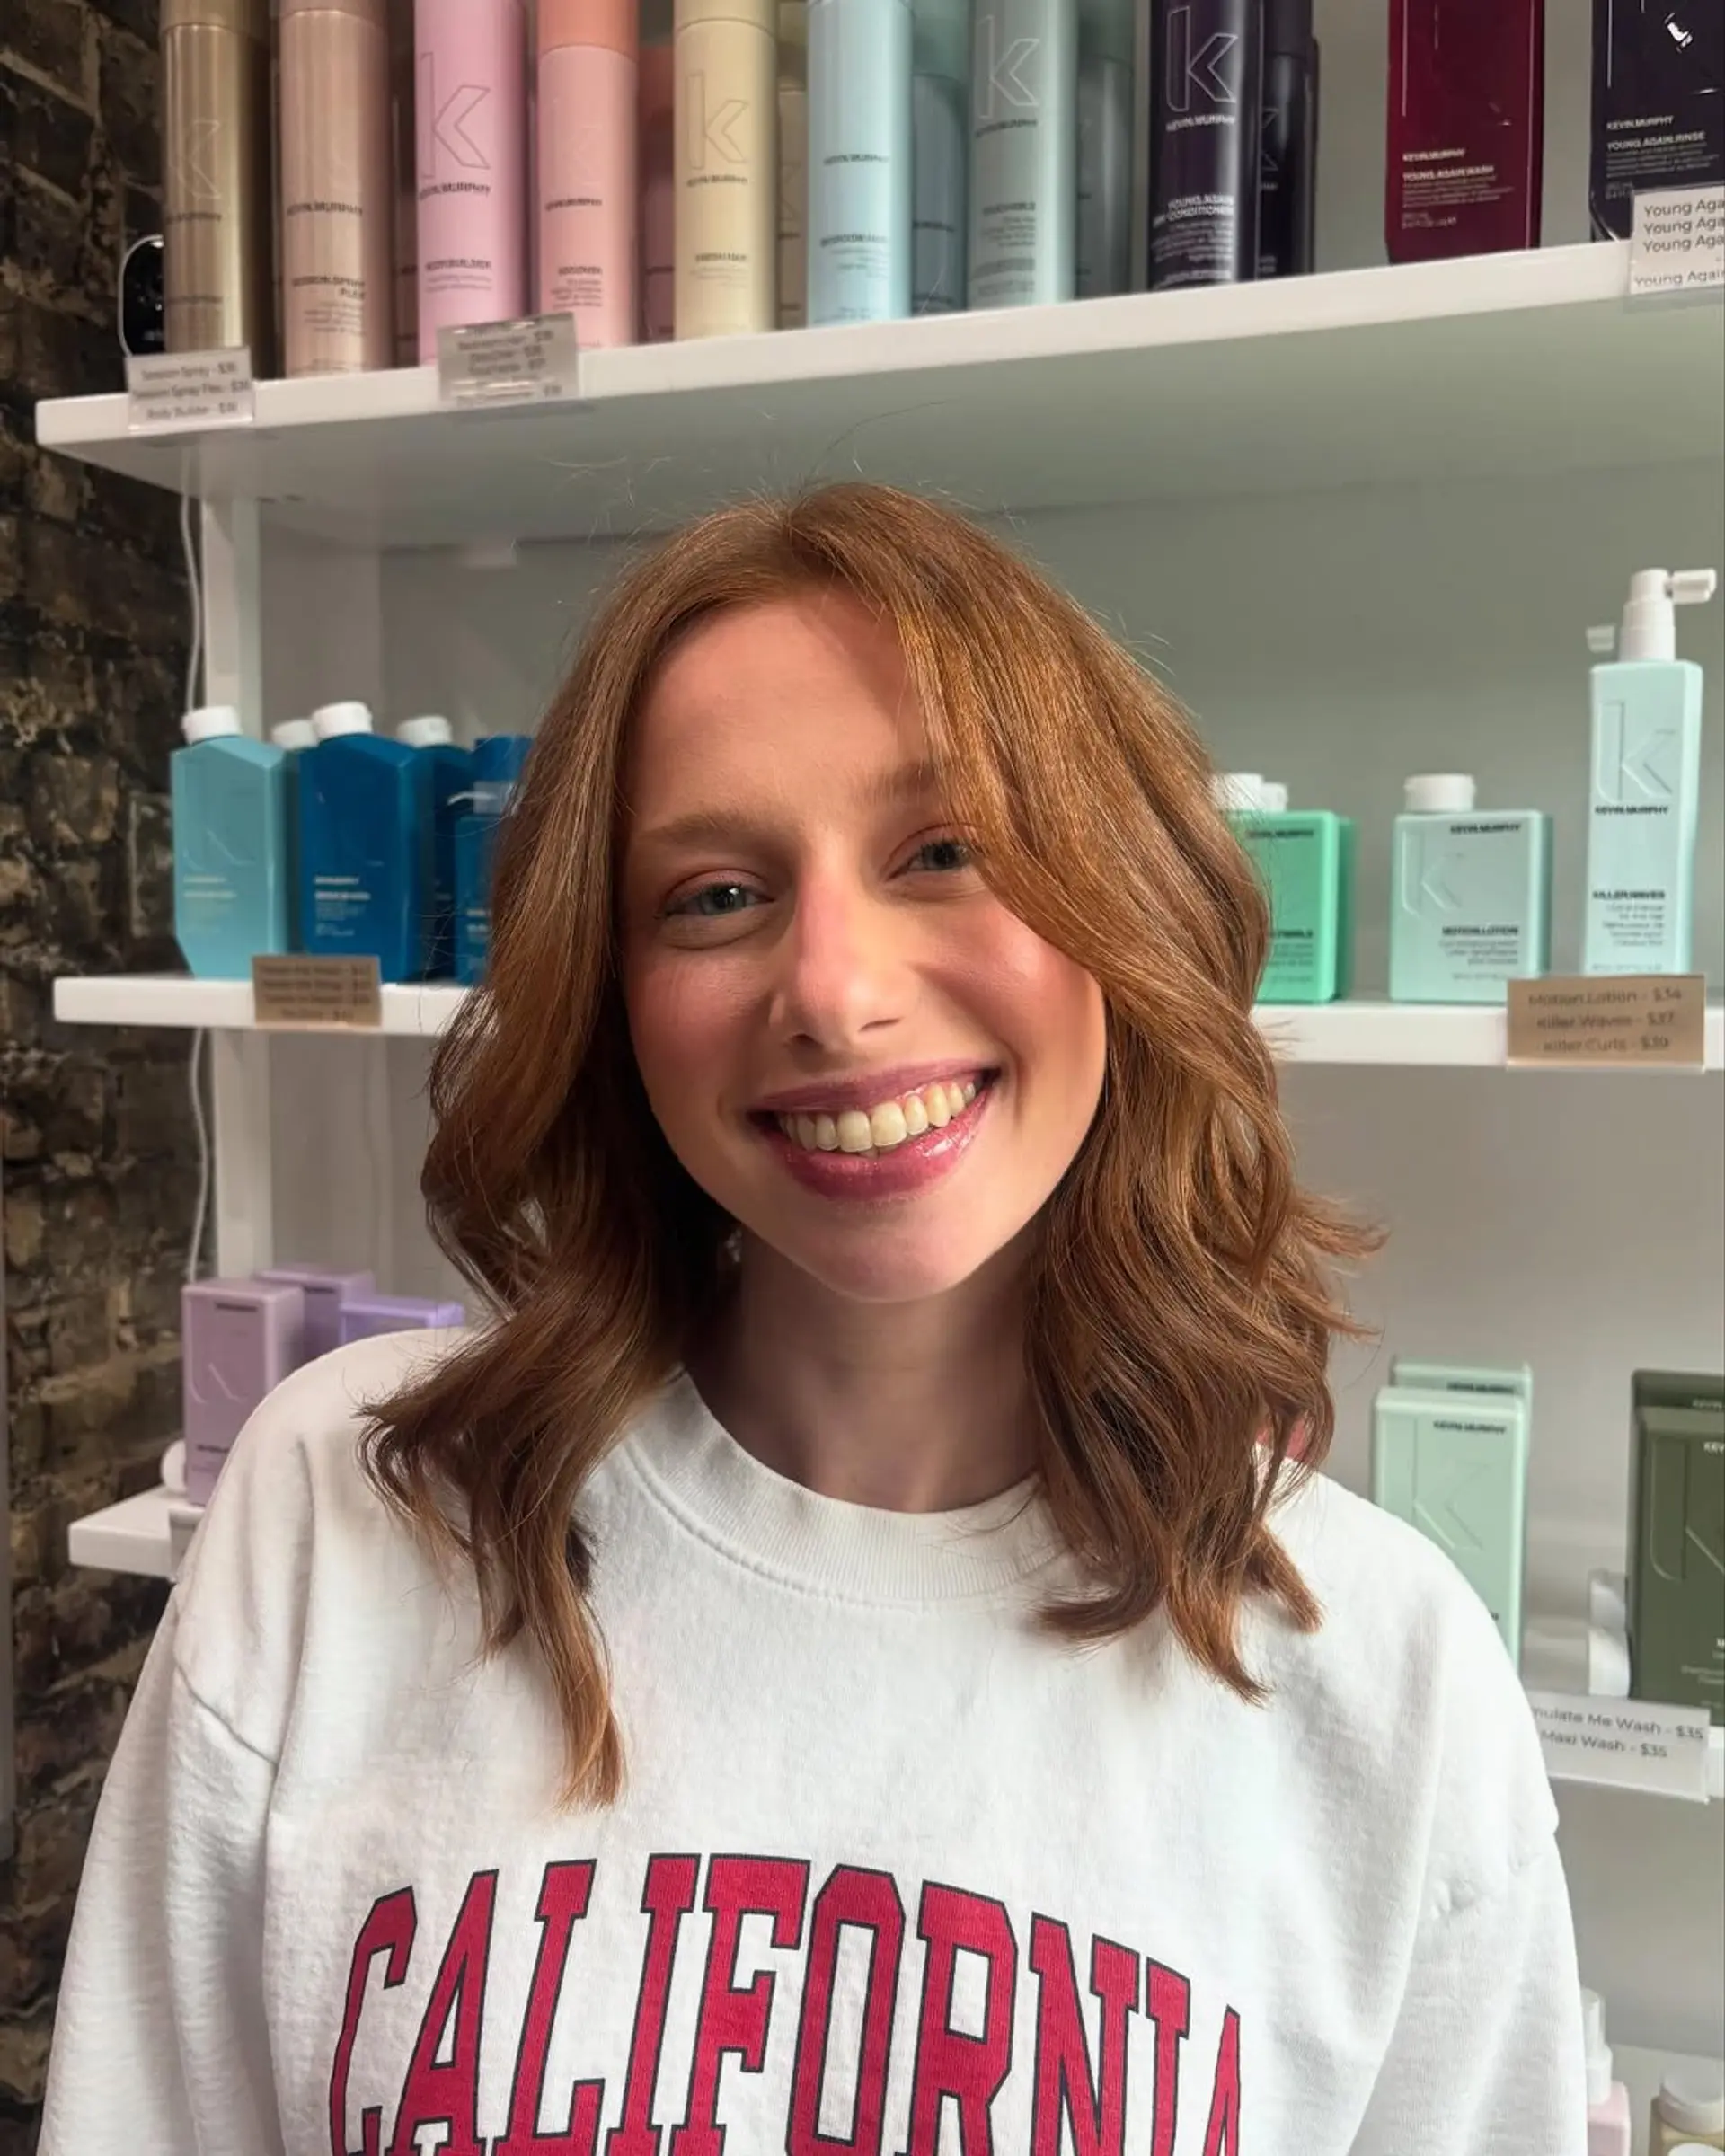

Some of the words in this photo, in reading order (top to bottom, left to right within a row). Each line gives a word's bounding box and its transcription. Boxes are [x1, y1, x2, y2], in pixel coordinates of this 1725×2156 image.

[1605, 115, 1674, 130] KEVIN.MURPHY
[1606, 130, 1706, 151] YOUNG.AGAIN.RINSE
[1643, 204, 1692, 216] Young
[1643, 221, 1692, 234] Young
[1643, 239, 1692, 252] Young
[1635, 274, 1683, 287] Young
[1587, 990, 1637, 1004] Lotion
[1616, 1717, 1662, 1736] Wash
[1580, 1735, 1625, 1752] Wash
[330, 1852, 1242, 2156] CALIFORNIA
